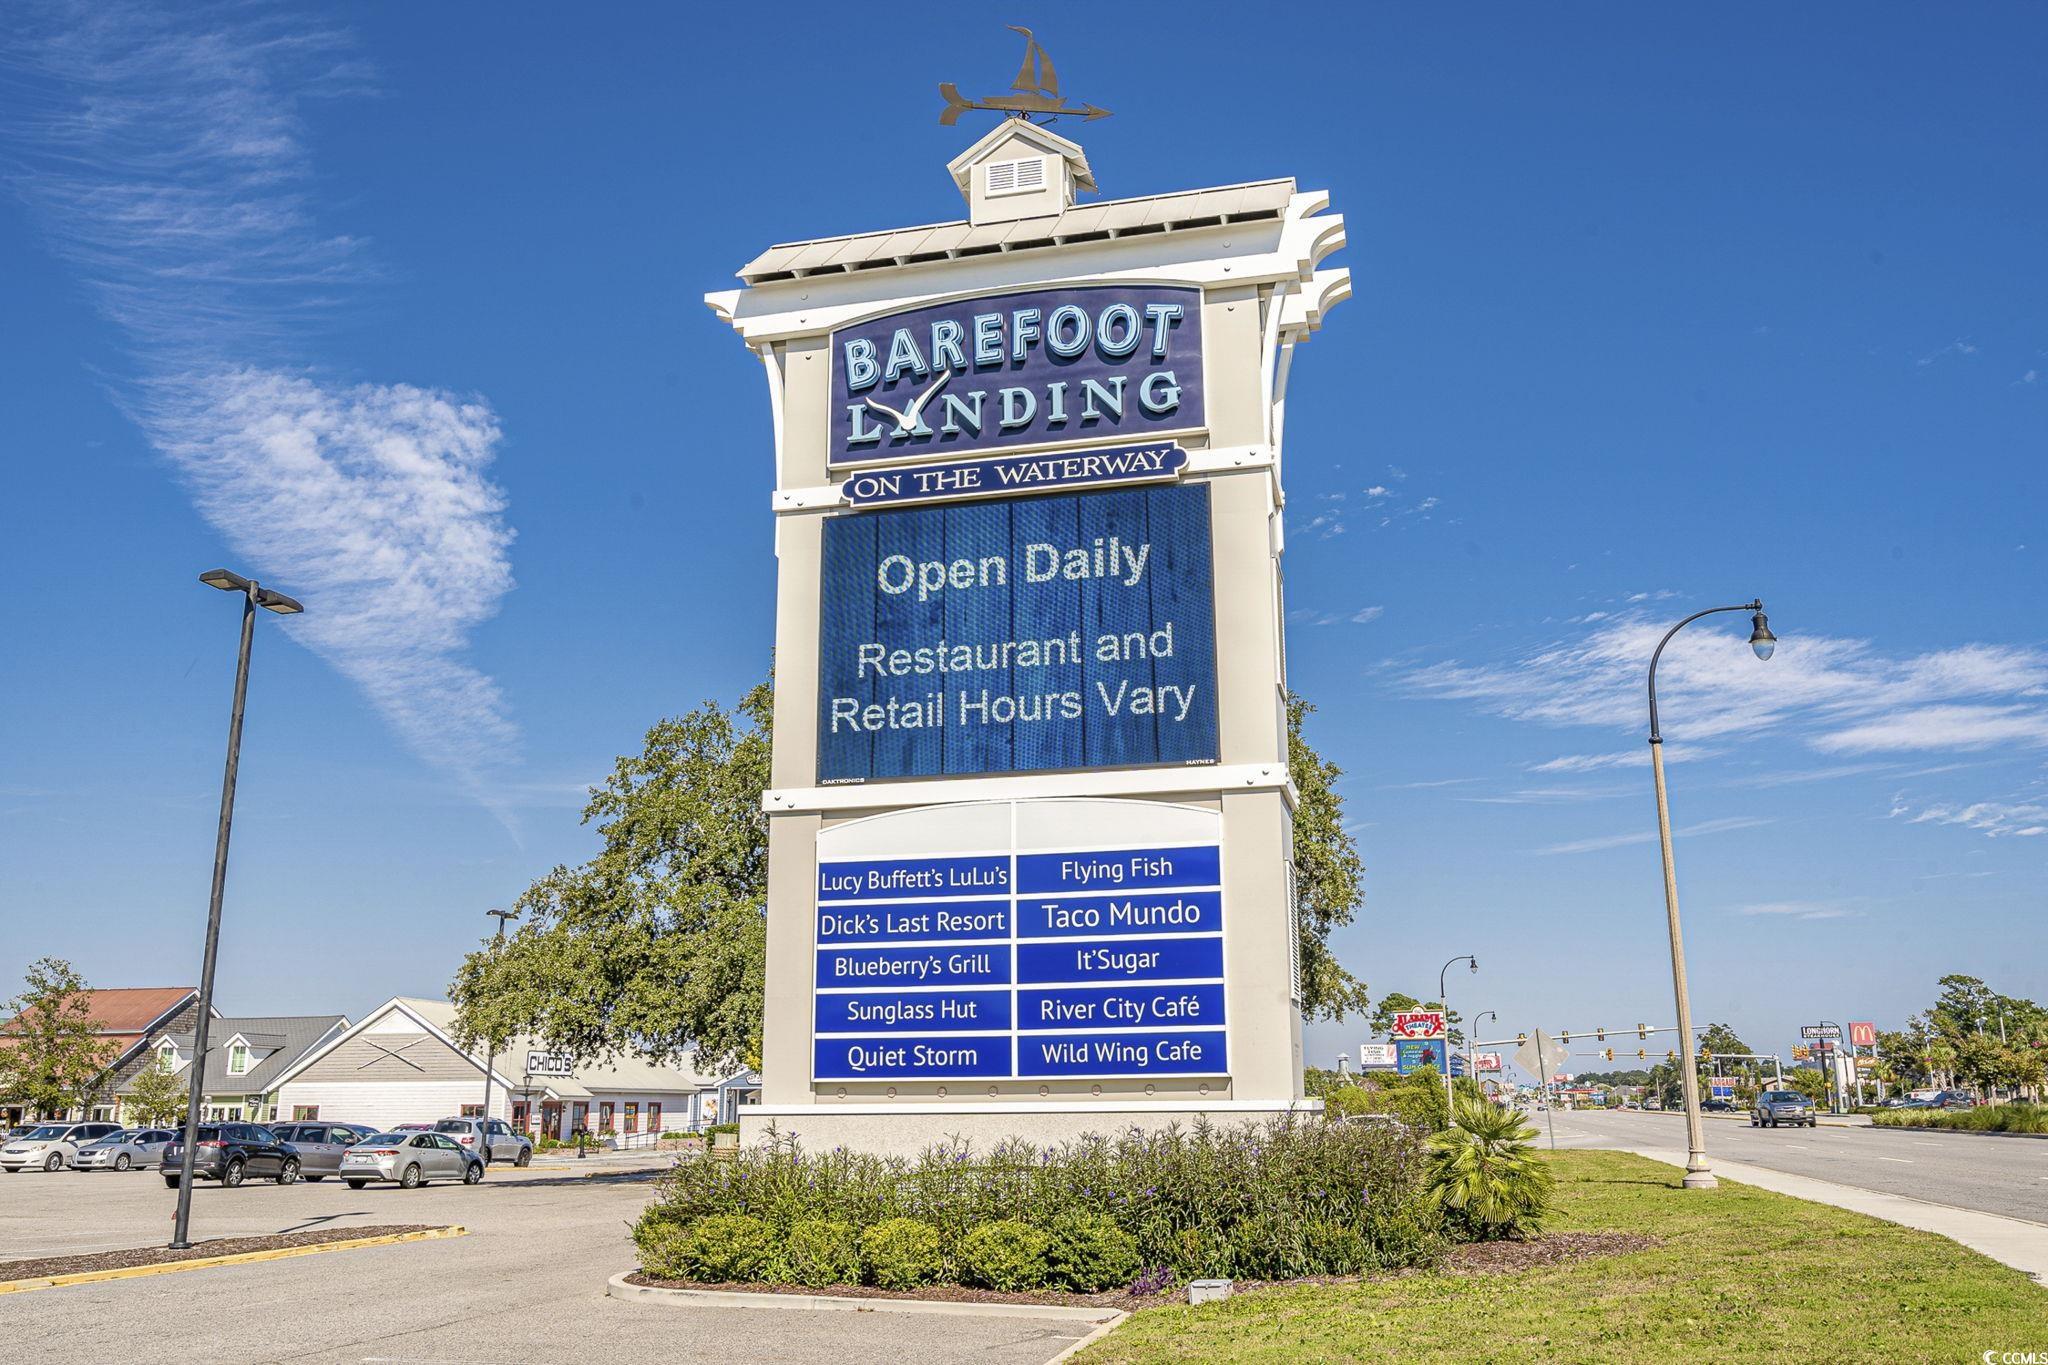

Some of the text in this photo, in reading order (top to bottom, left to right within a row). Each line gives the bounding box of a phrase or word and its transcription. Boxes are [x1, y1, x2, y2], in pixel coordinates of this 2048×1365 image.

[844, 304, 1184, 390] BAREFOOT
[846, 371, 1183, 443] LANDING
[854, 449, 1169, 498] ON THE WATERWAY
[877, 537, 1151, 601] Open Daily
[858, 622, 1174, 678] Restaurant and
[831, 680, 1196, 733] Retail Hours Vary
[822, 777, 865, 785] DAKTRONICS
[822, 867, 1007, 894] Lucy Buffett's LuLu's
[1063, 857, 1172, 883] Flying Fish
[822, 912, 1005, 935] Dick's Last Resort
[1042, 900, 1200, 928] Taco Mundo
[836, 954, 990, 979] Blueberry's Grill
[848, 1000, 976, 1024] Sunglass Hut
[1042, 996, 1199, 1022] River City Café
[848, 1046, 976, 1071] Quiet Storm
[1042, 1041, 1201, 1066] Wild Wing Cafe
